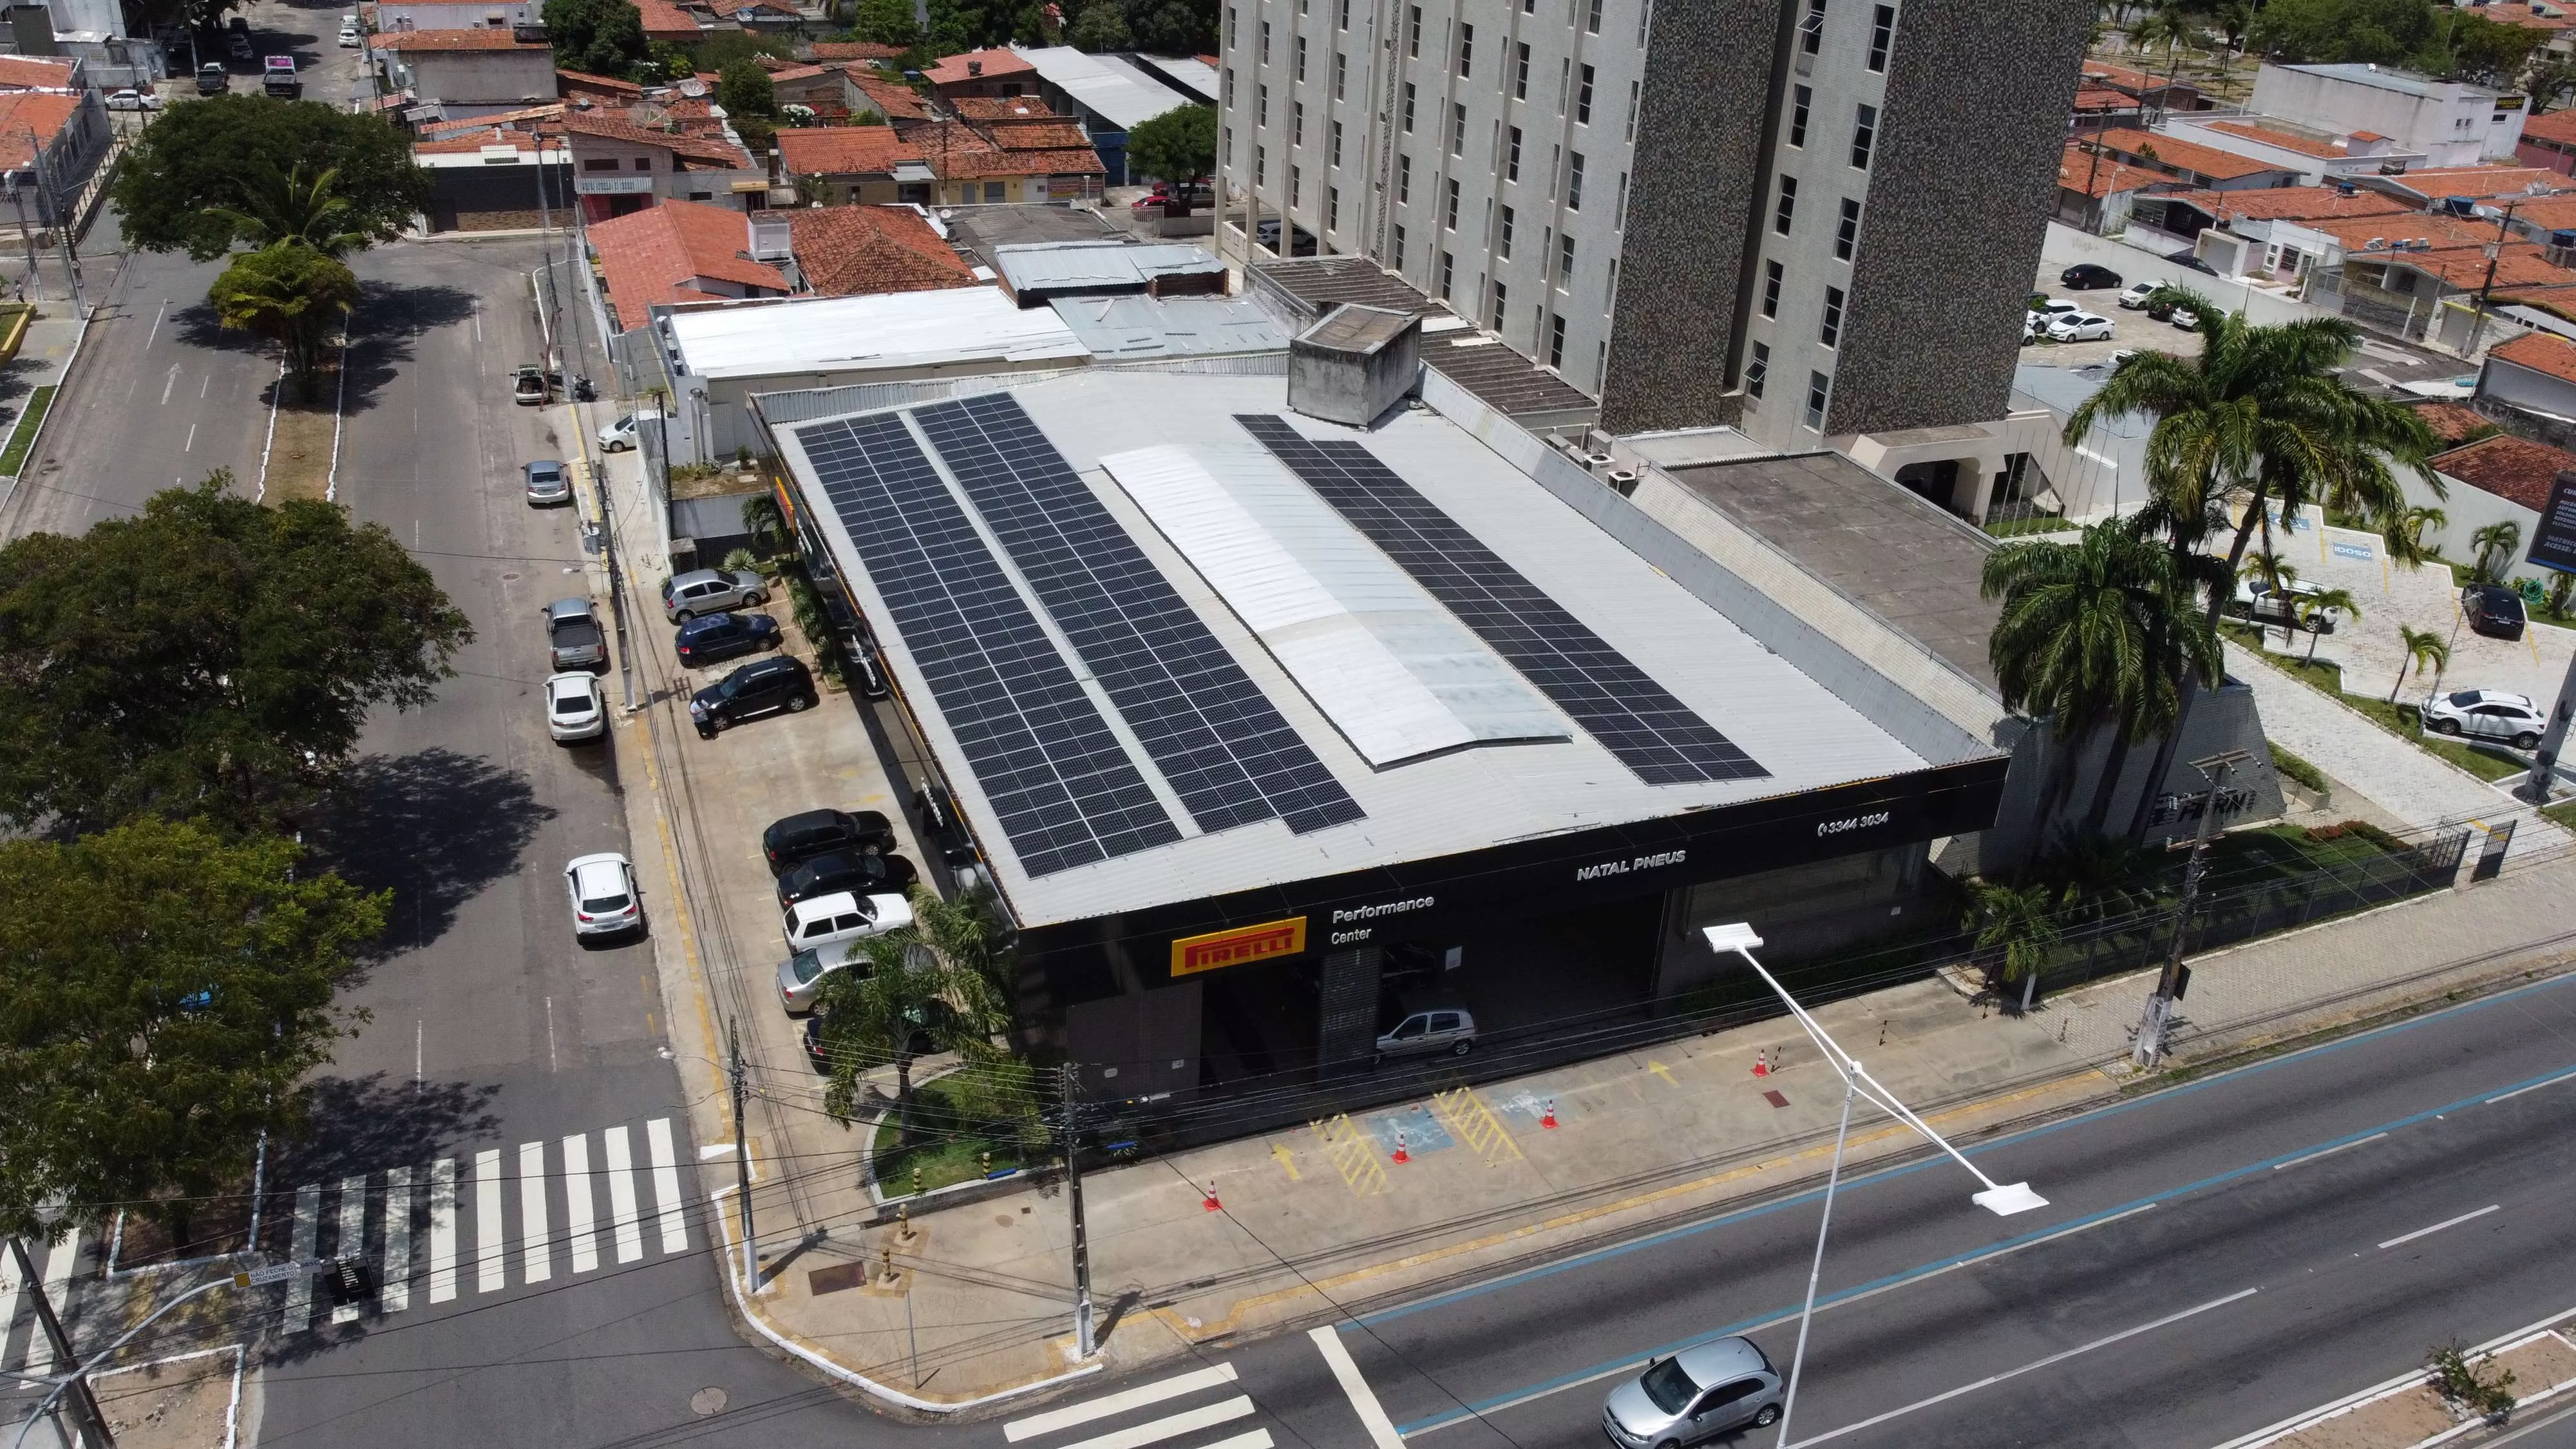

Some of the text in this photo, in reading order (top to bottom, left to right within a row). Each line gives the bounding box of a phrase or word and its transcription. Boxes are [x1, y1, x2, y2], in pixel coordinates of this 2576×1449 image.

[2334, 546, 2371, 558] IDOSO
[1828, 811, 1889, 833] 3344 3034
[1577, 850, 1686, 881] NATAL PNEUS
[1332, 896, 1435, 923] Performance
[1331, 928, 1372, 945] Center
[1184, 927, 1295, 969] PIRELLI
[251, 1271, 295, 1283] CRUZAMENTO
[266, 1266, 287, 1275] FECHE
